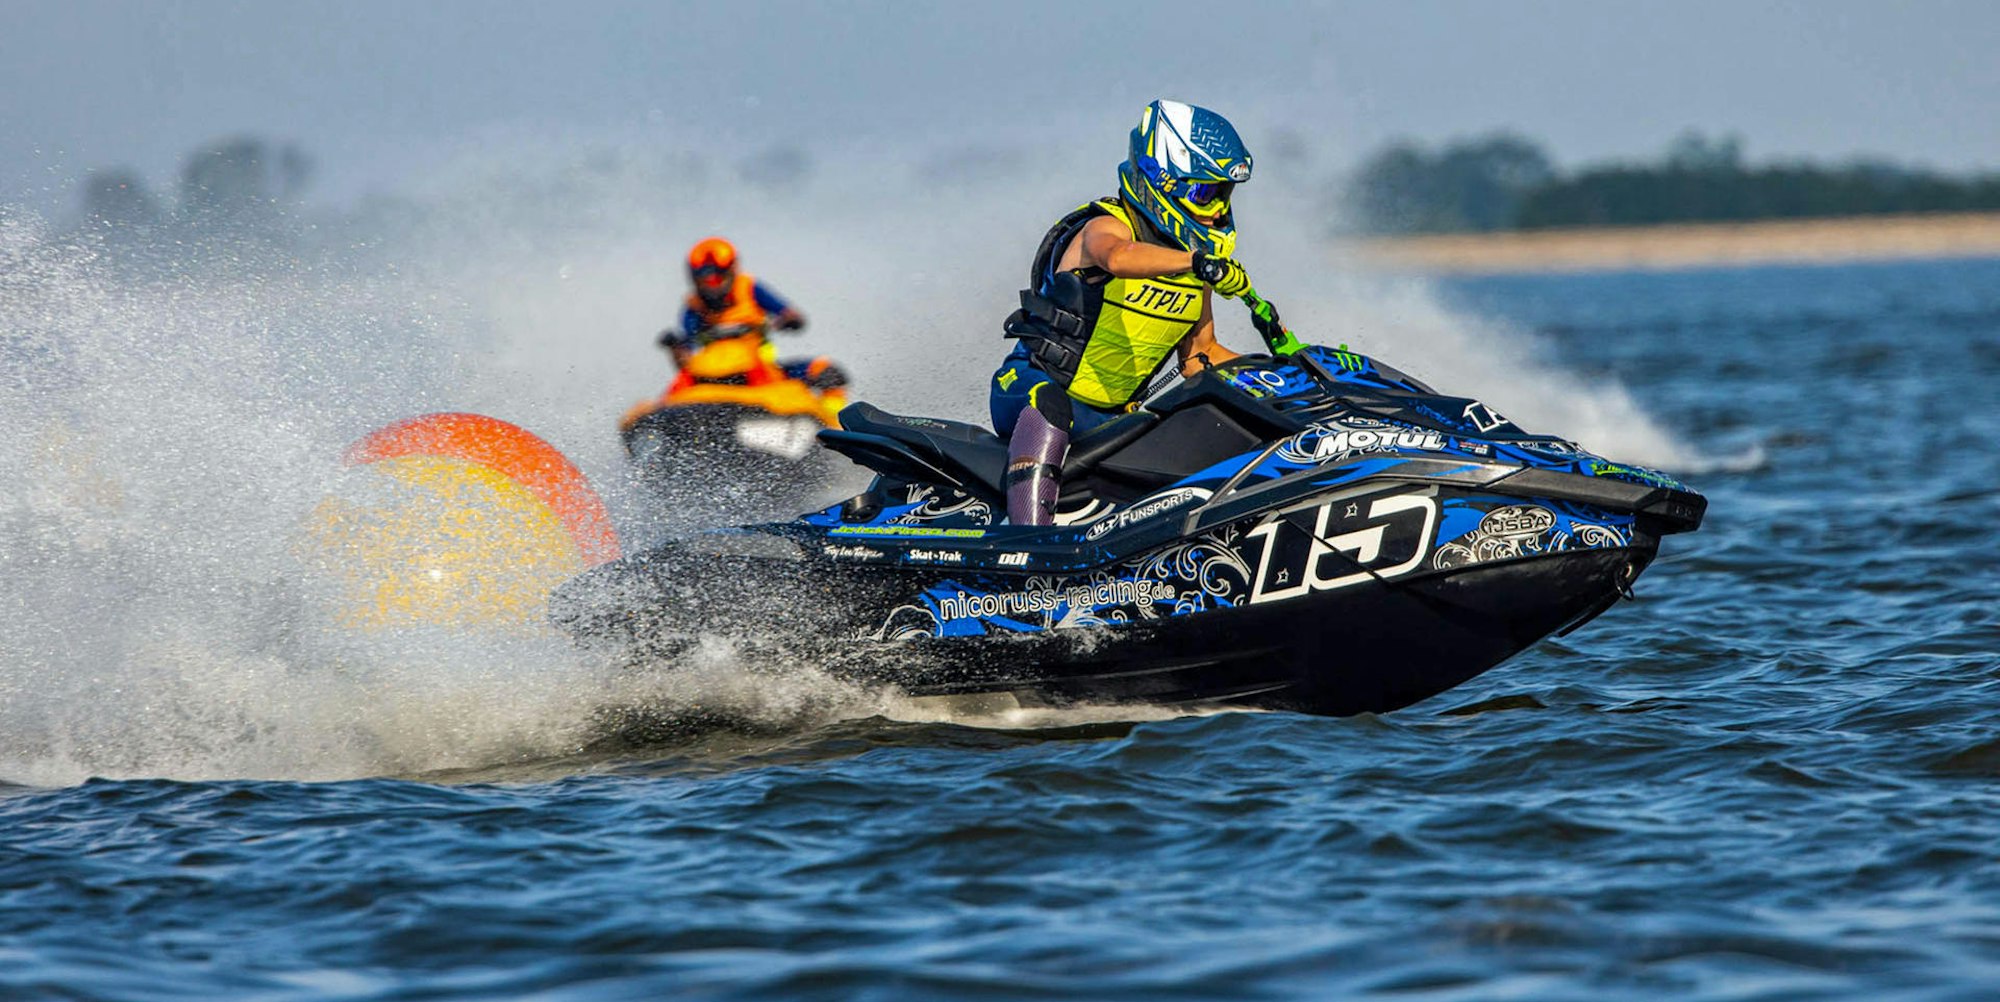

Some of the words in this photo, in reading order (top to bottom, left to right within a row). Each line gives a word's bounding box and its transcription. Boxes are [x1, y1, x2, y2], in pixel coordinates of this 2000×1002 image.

[1125, 284, 1197, 315] JTPLT
[1313, 430, 1447, 460] MOTUL
[1488, 512, 1549, 532] IJSBA
[1246, 495, 1436, 604] 15
